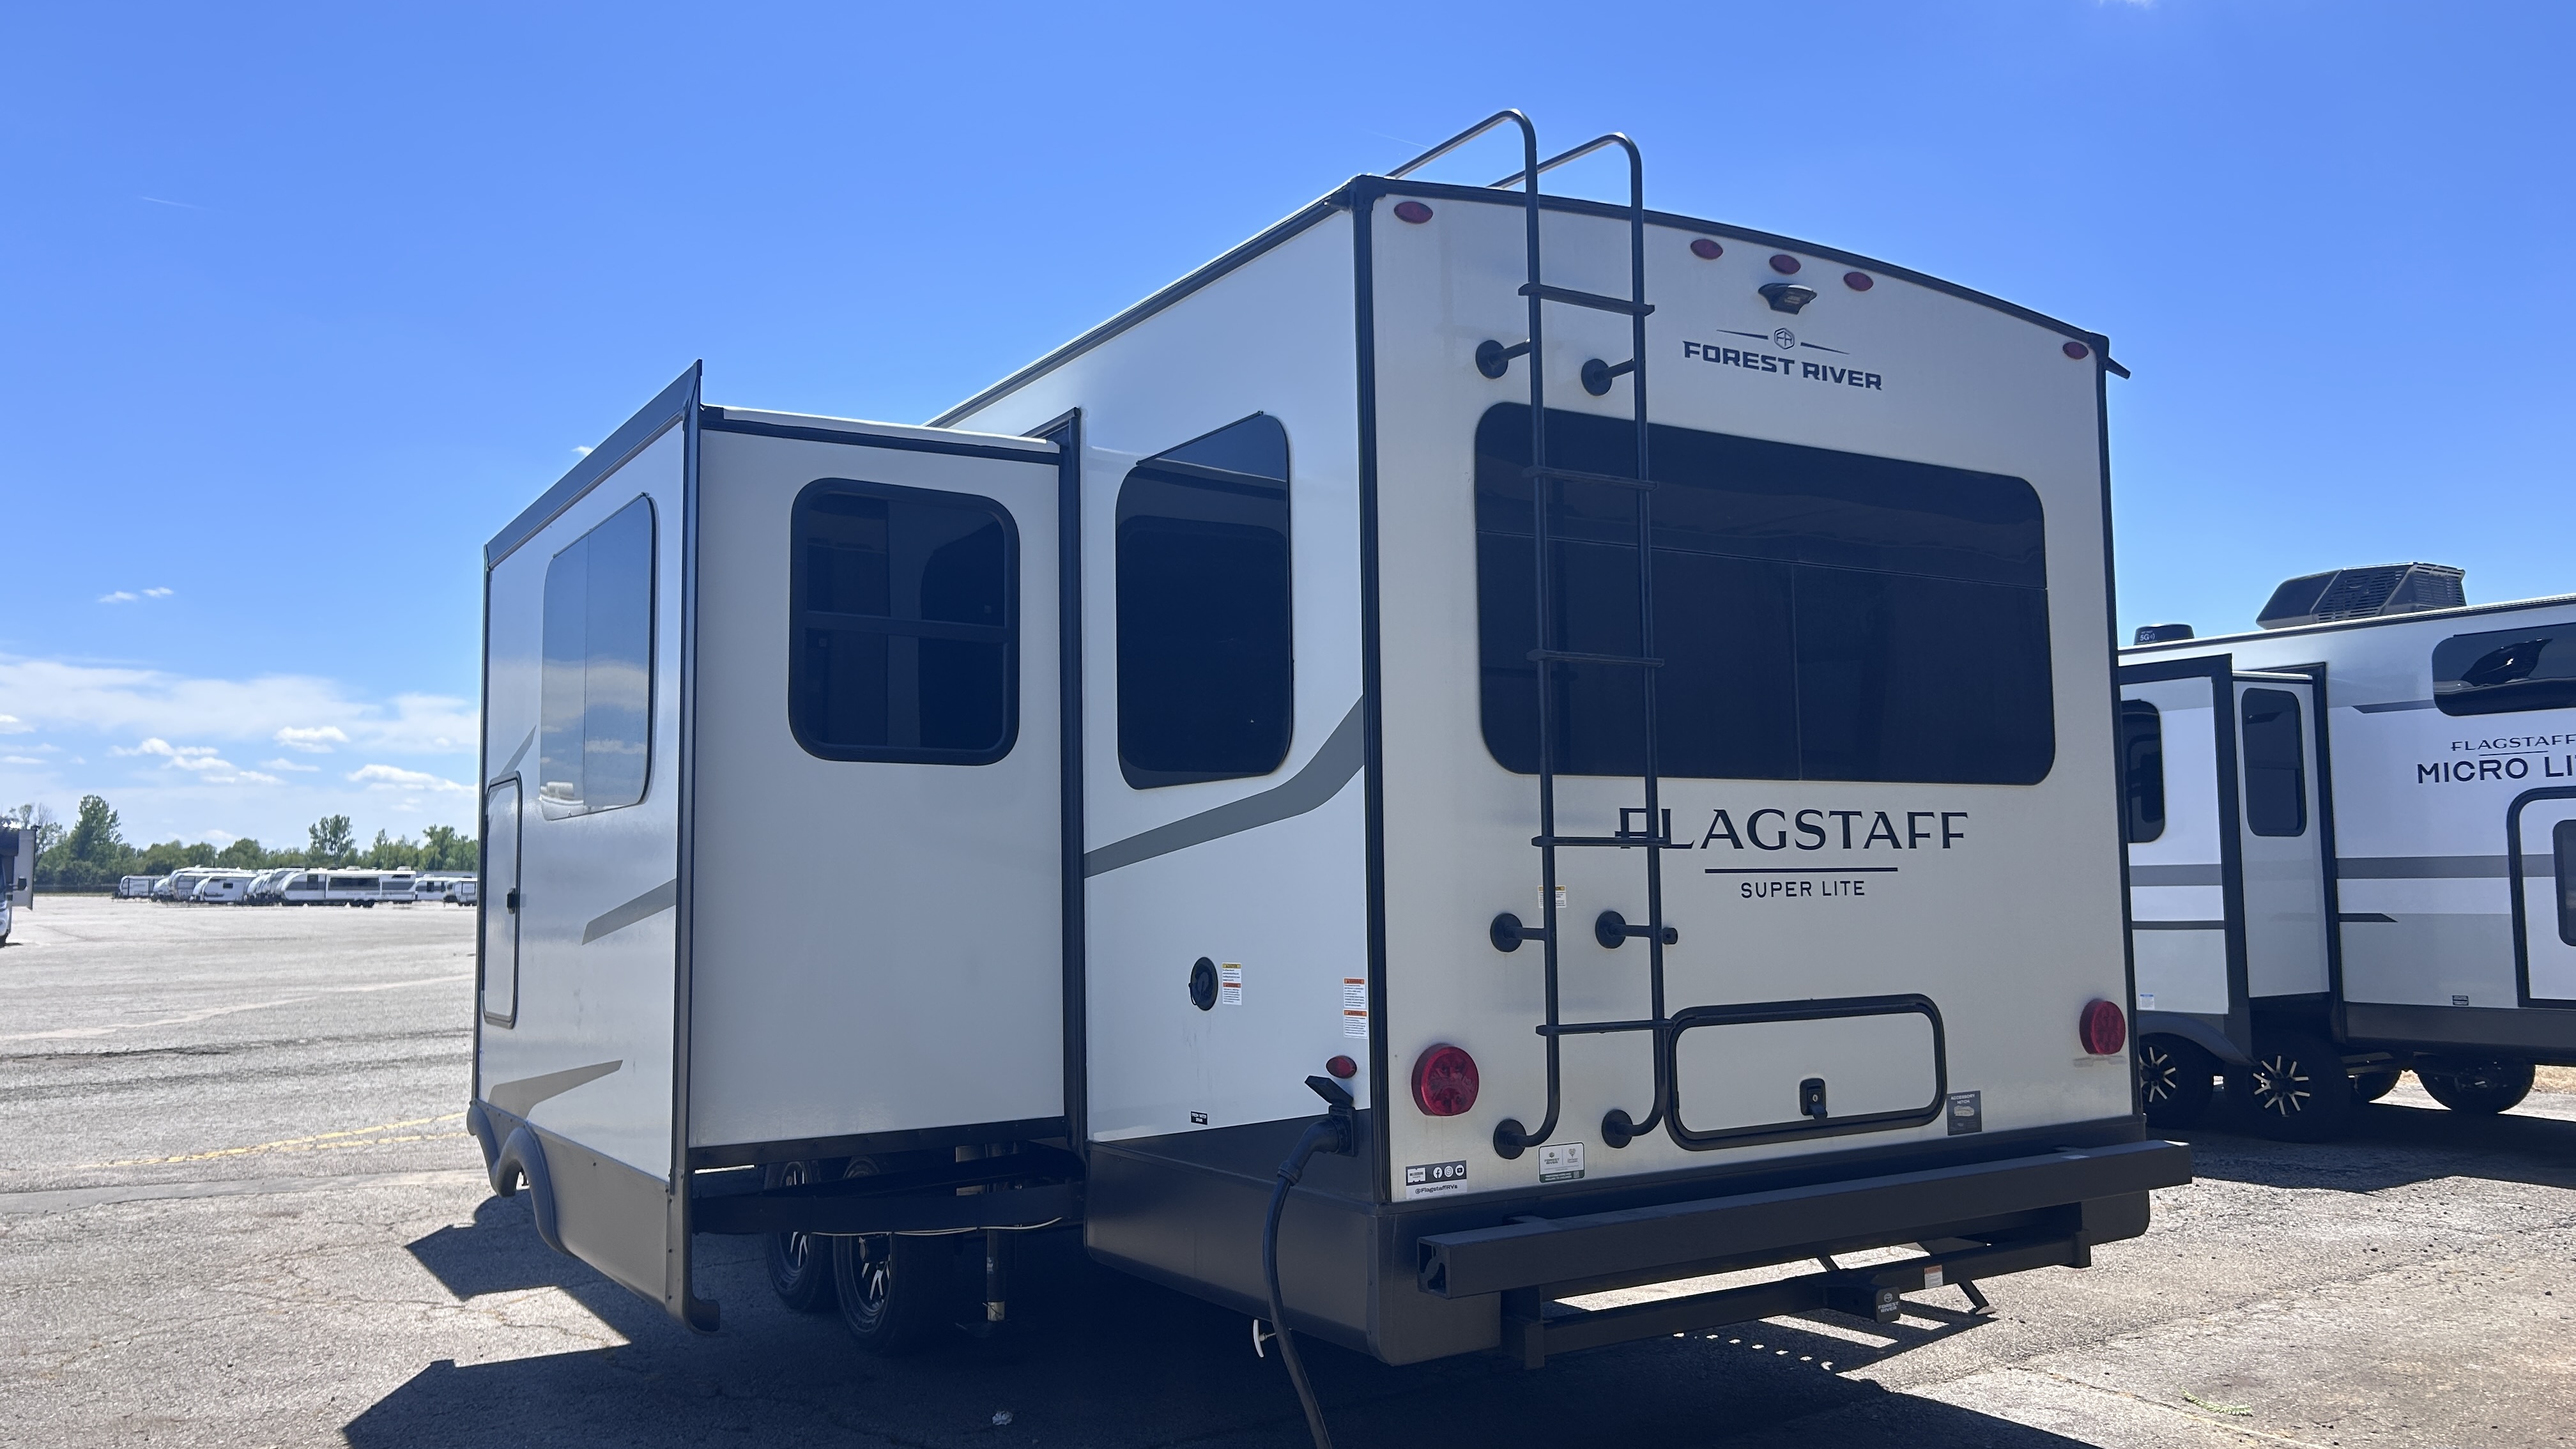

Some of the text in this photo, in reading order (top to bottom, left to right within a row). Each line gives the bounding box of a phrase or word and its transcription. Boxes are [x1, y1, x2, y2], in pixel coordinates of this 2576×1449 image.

[1682, 341, 1882, 390] FOREST RIVER
[2450, 734, 2576, 751] FLAGSTAFF
[2417, 755, 2576, 784] MICRO LI
[1614, 808, 1968, 851] FLAGSTAFF
[1740, 880, 1865, 898] SUPER LITE
[1878, 1301, 1899, 1310] FOREST
